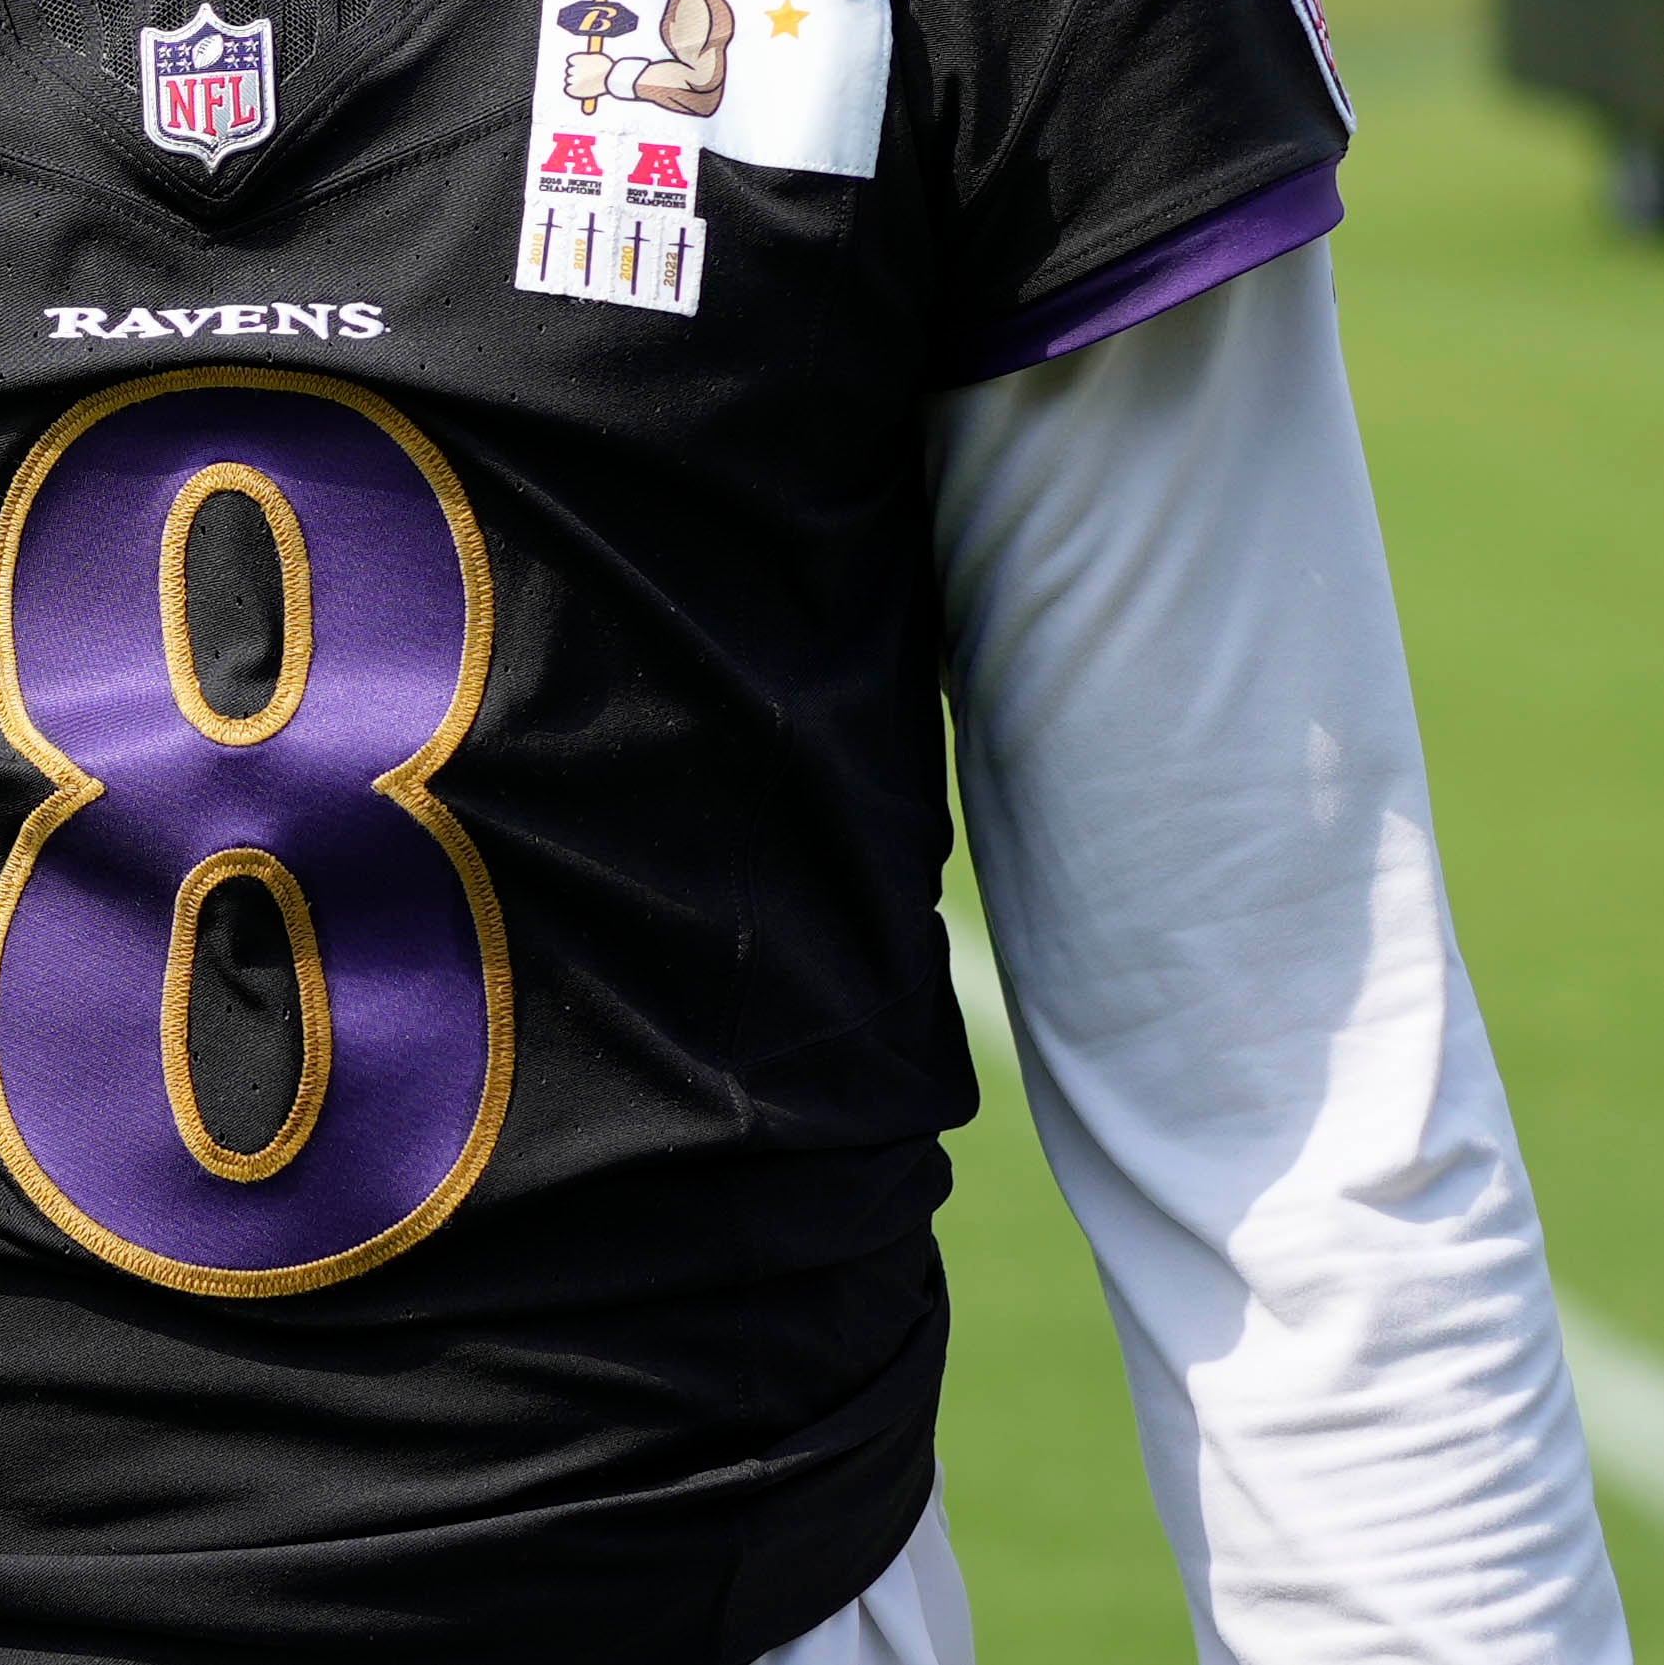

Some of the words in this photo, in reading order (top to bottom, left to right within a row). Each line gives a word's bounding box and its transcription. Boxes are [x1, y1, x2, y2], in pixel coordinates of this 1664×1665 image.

[578, 6, 618, 32] B
[165, 75, 256, 137] NFL
[540, 132, 603, 177] A
[627, 142, 688, 189] A
[538, 184, 602, 196] CHAMPIONS
[568, 179, 602, 189] NORTH
[654, 191, 687, 201] NORTH
[626, 195, 687, 209] CHAMPIONS
[573, 238, 587, 271] 2019
[619, 245, 634, 281] 2020
[663, 251, 678, 287] 2022
[43, 300, 386, 340] RAVENS
